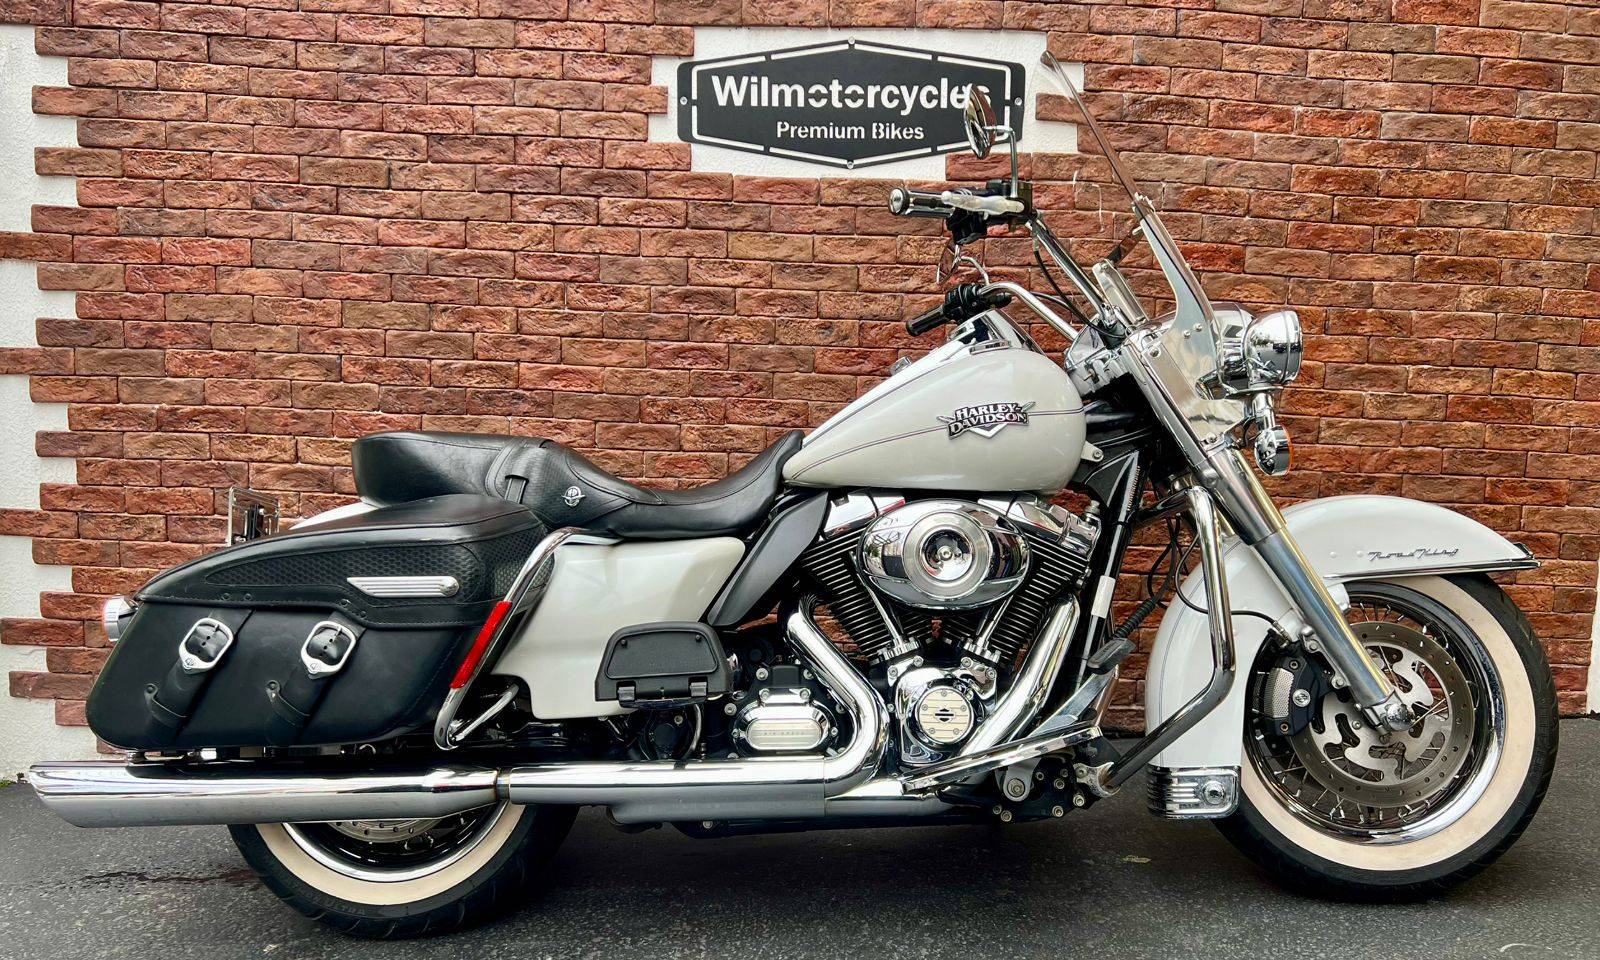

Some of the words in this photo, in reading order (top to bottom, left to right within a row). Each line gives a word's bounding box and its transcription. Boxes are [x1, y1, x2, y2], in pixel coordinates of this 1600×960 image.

[776, 121, 865, 139] Premium
[872, 123, 925, 140] Bikes
[949, 412, 1027, 434] DAVIDSON
